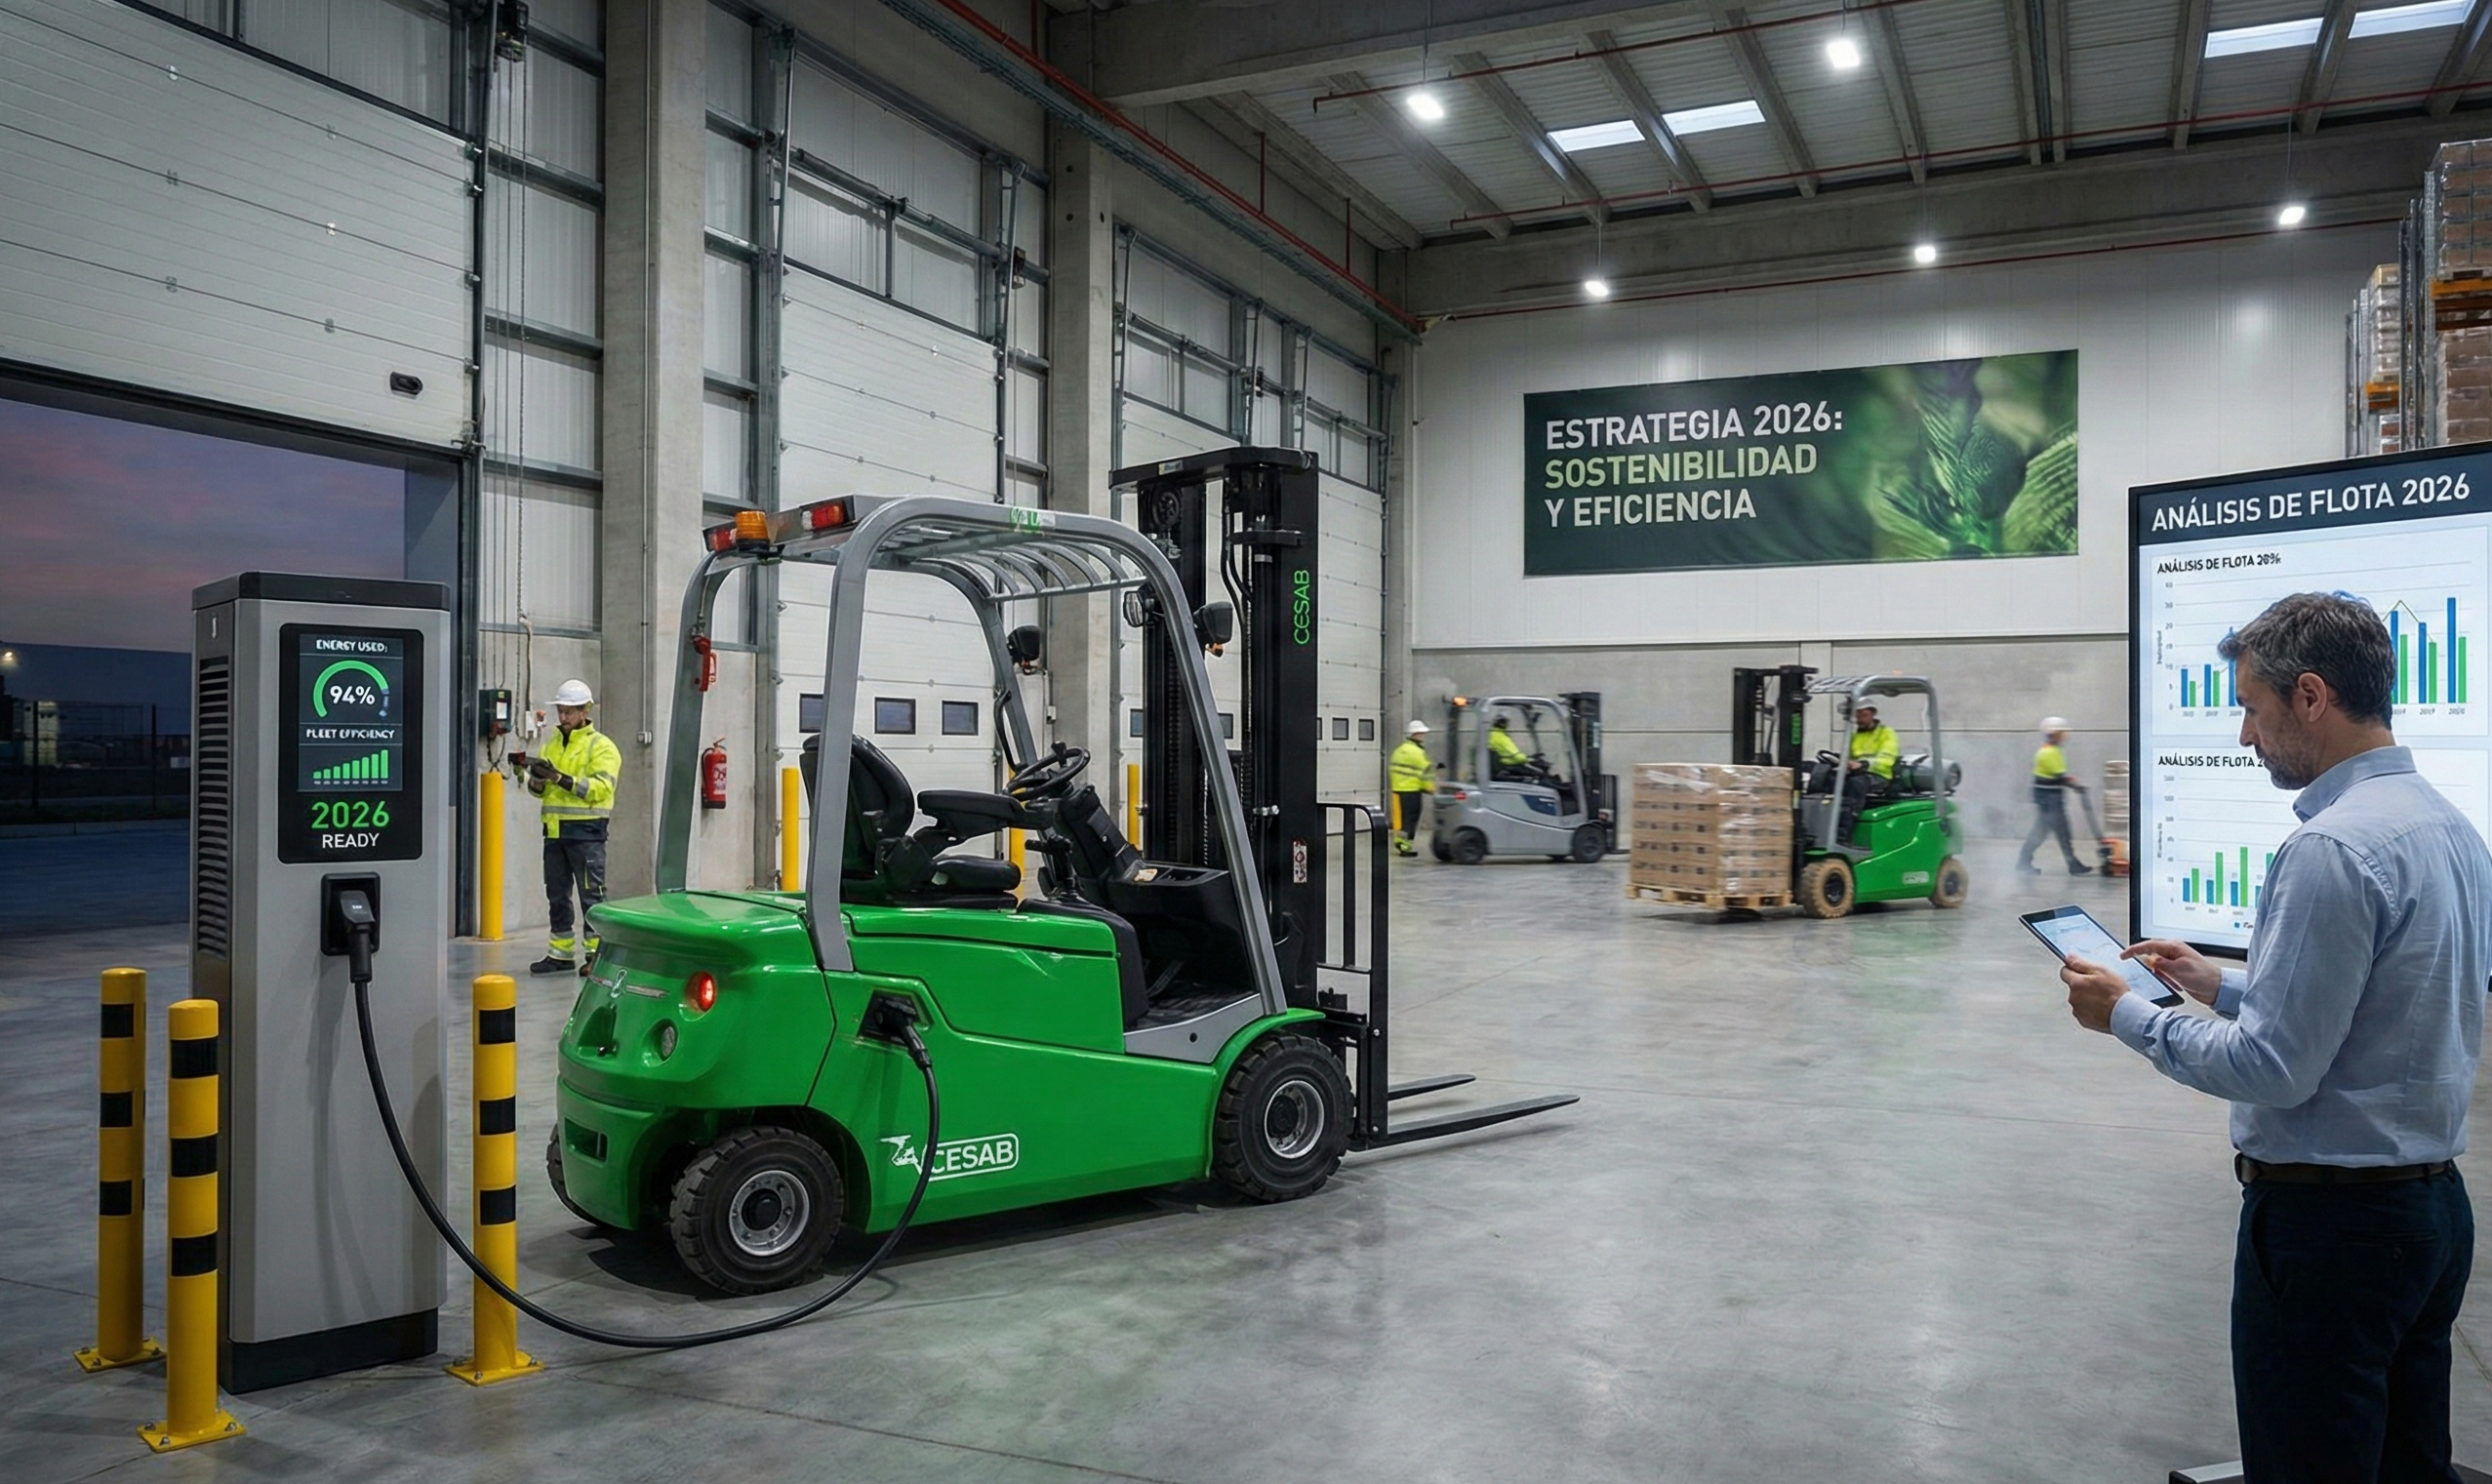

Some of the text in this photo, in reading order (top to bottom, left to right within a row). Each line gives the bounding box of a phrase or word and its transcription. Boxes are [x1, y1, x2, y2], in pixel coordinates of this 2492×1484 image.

[1547, 400, 1844, 451] ESTRATEGIA 2026:
[1545, 443, 1818, 489] SOSTENIBILIDAD
[1545, 489, 1757, 528] Y EFICIENCIA
[2151, 473, 2471, 532] ANÁLISIS DE FLOTA 2026
[2156, 558, 2203, 574] ANÁLISIS
[2206, 557, 2220, 570] DE
[2222, 555, 2255, 569] FLOTA
[1294, 570, 1310, 645] CESAB
[330, 685, 376, 705] 94%
[2158, 752, 2204, 767] ANÁLISIS
[2206, 755, 2220, 767] DE
[2222, 755, 2256, 768] FLOTA
[311, 800, 390, 829] 2026
[322, 832, 381, 849] READY
